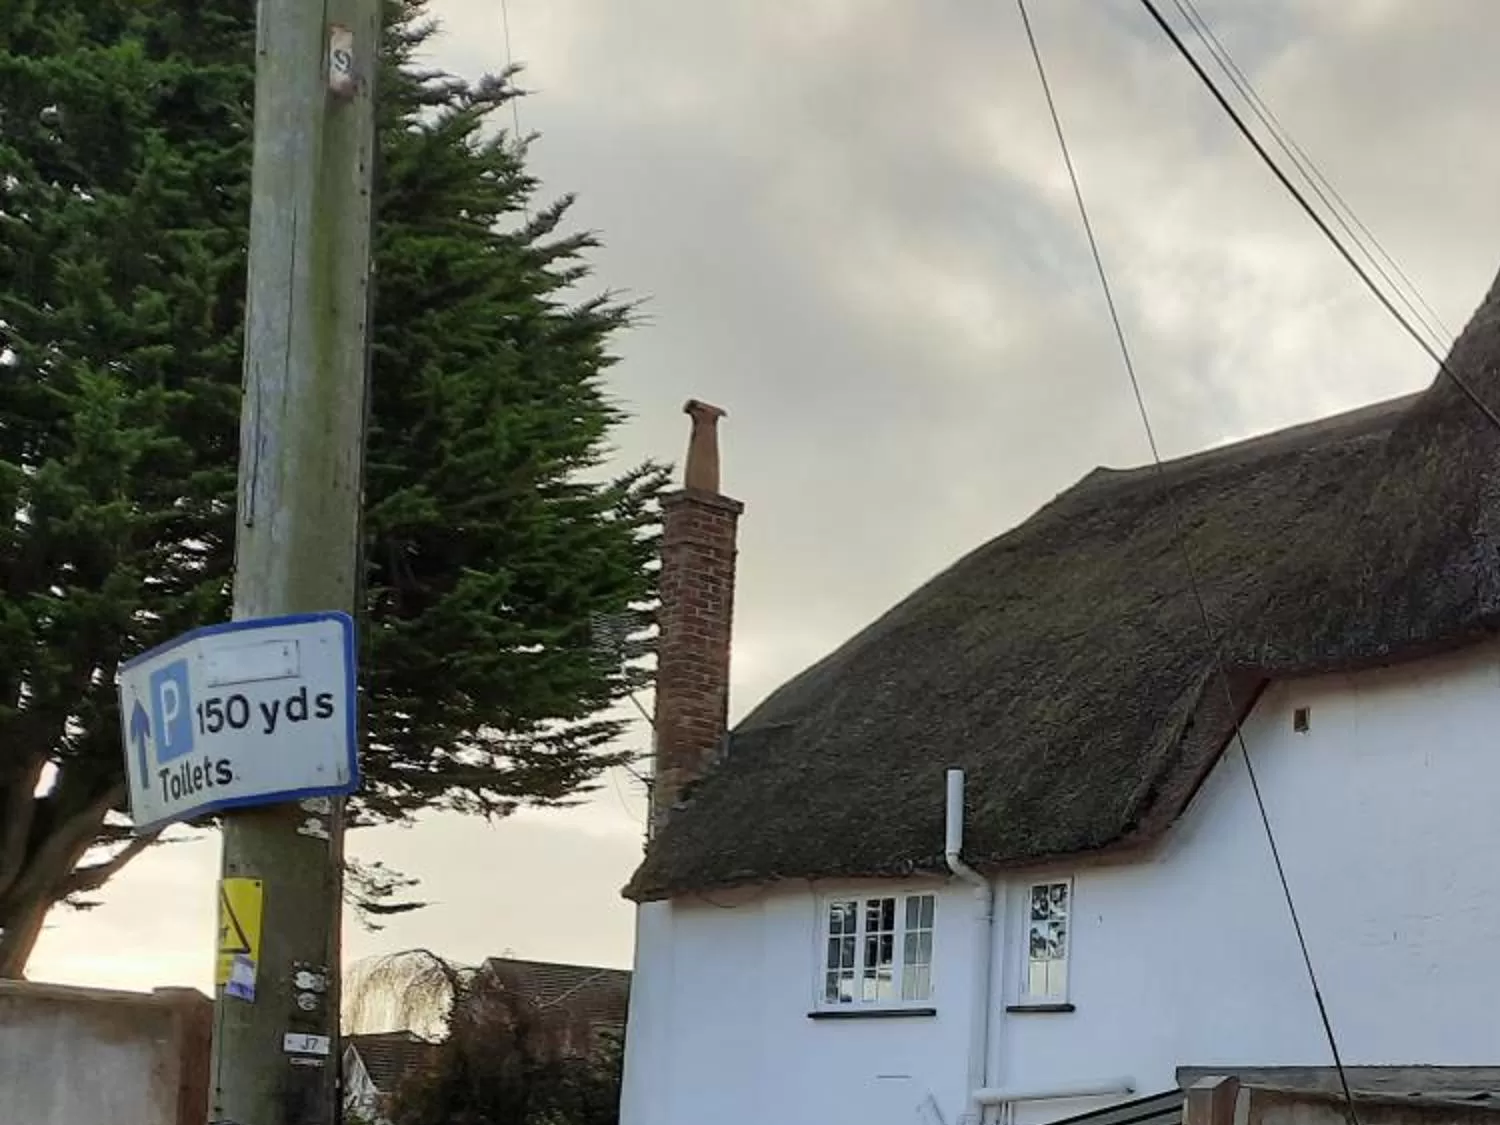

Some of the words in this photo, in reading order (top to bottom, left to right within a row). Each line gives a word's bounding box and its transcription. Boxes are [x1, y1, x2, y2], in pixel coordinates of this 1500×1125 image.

[196, 694, 250, 735] 150
[260, 687, 334, 734] yds
[158, 756, 233, 803] Toilets
